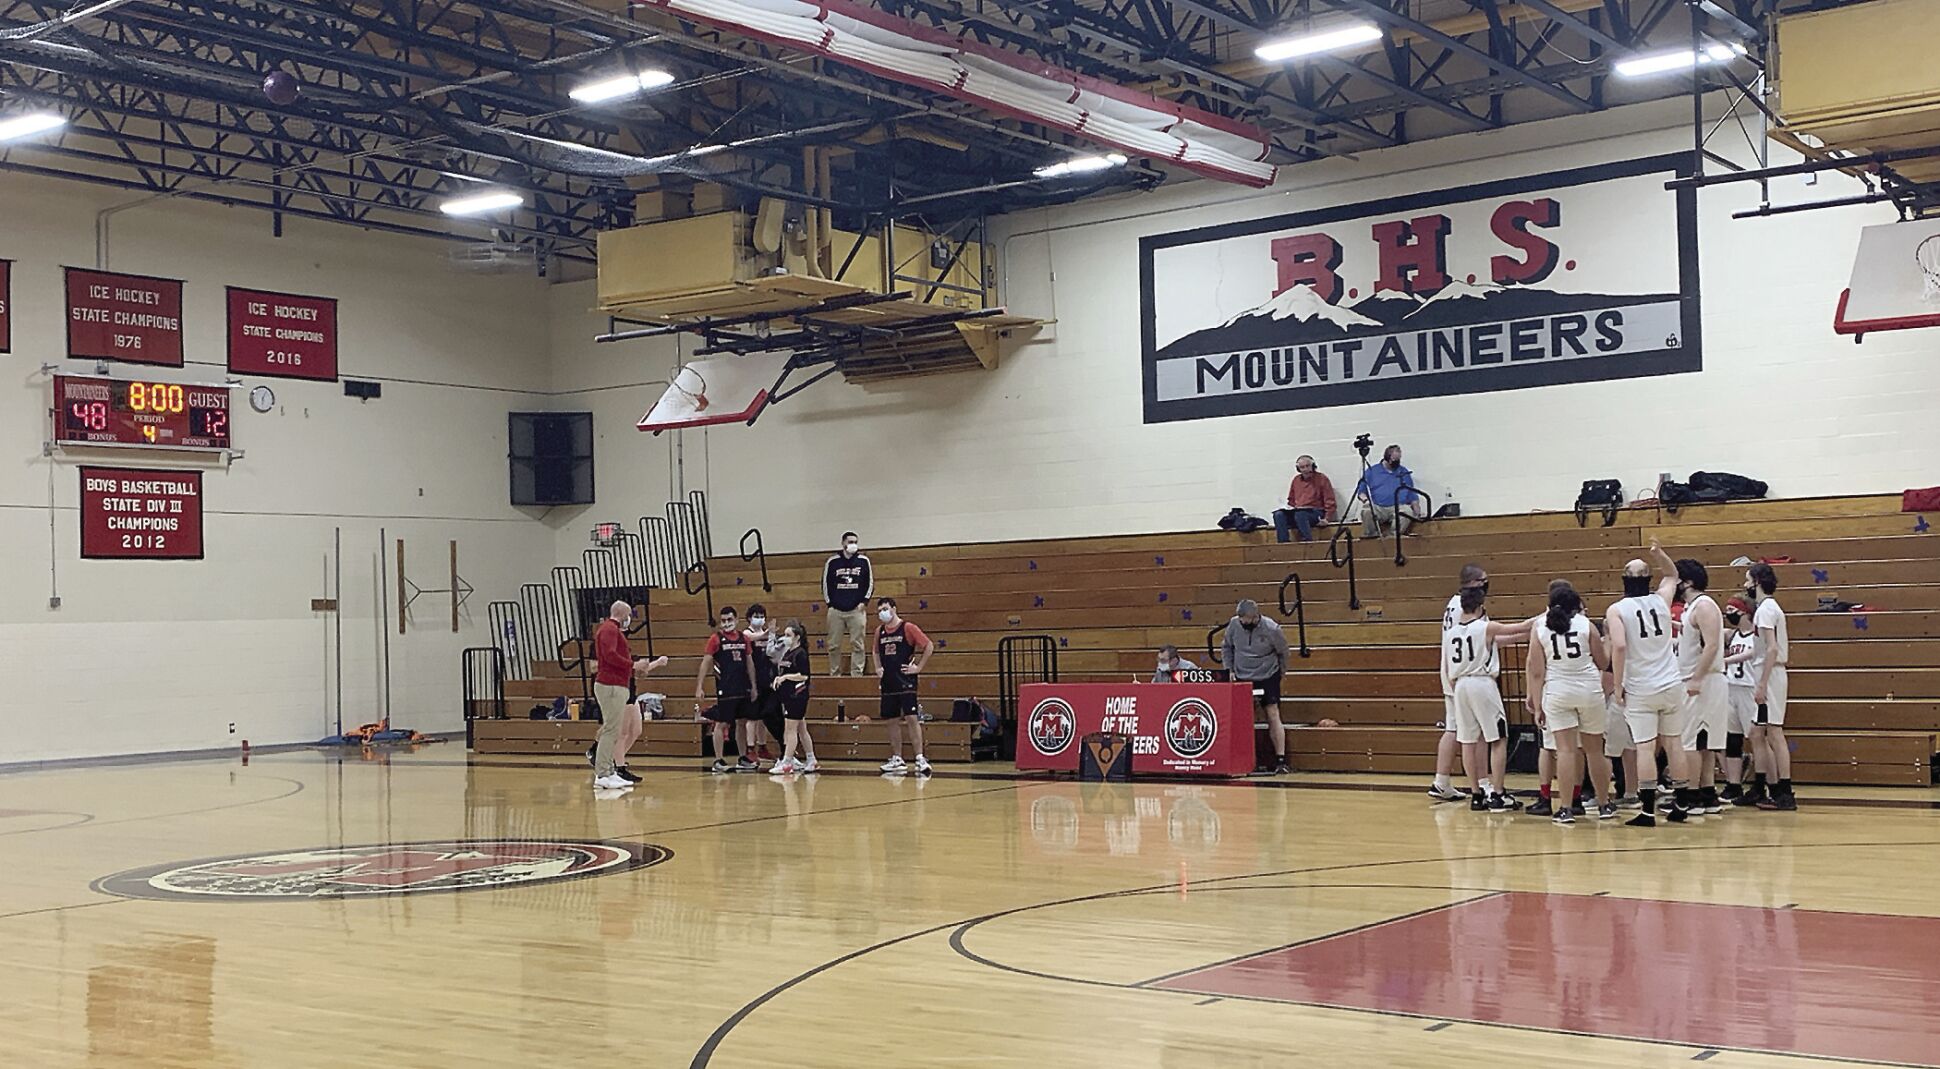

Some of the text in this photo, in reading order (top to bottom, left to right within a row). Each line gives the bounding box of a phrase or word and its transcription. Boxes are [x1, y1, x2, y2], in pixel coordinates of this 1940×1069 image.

[1271, 198, 1576, 306] B.H.S.
[89, 285, 160, 305] ICE HOCKEY
[73, 307, 178, 330] STATE CHAMPIONS
[248, 302, 318, 321] ICE HOCKEY
[114, 334, 142, 349] 1976
[243, 324, 324, 343] STATE CHAMPIONS
[266, 350, 301, 366] 2016
[1196, 310, 1624, 394] MOUNTAINEERS
[130, 382, 184, 413] 8:00
[188, 392, 228, 409] GUEST
[73, 403, 106, 430] 48
[133, 414, 165, 423] PERIOD
[206, 411, 226, 437] 12
[87, 432, 118, 441] BONUS
[143, 424, 156, 443] 4
[181, 438, 210, 447] BONUS
[86, 478, 197, 496] BOYS BASKETBALL
[103, 497, 183, 513] STATE DIV III
[107, 516, 178, 531] CHAMPIONS
[122, 534, 165, 549] 2012
[1636, 608, 1663, 639] 11
[1451, 635, 1475, 664] 31
[1550, 631, 1582, 660] 15
[1181, 669, 1216, 683] POSS.
[1105, 696, 1137, 715] HOME
[1101, 716, 1139, 735] OF THE
